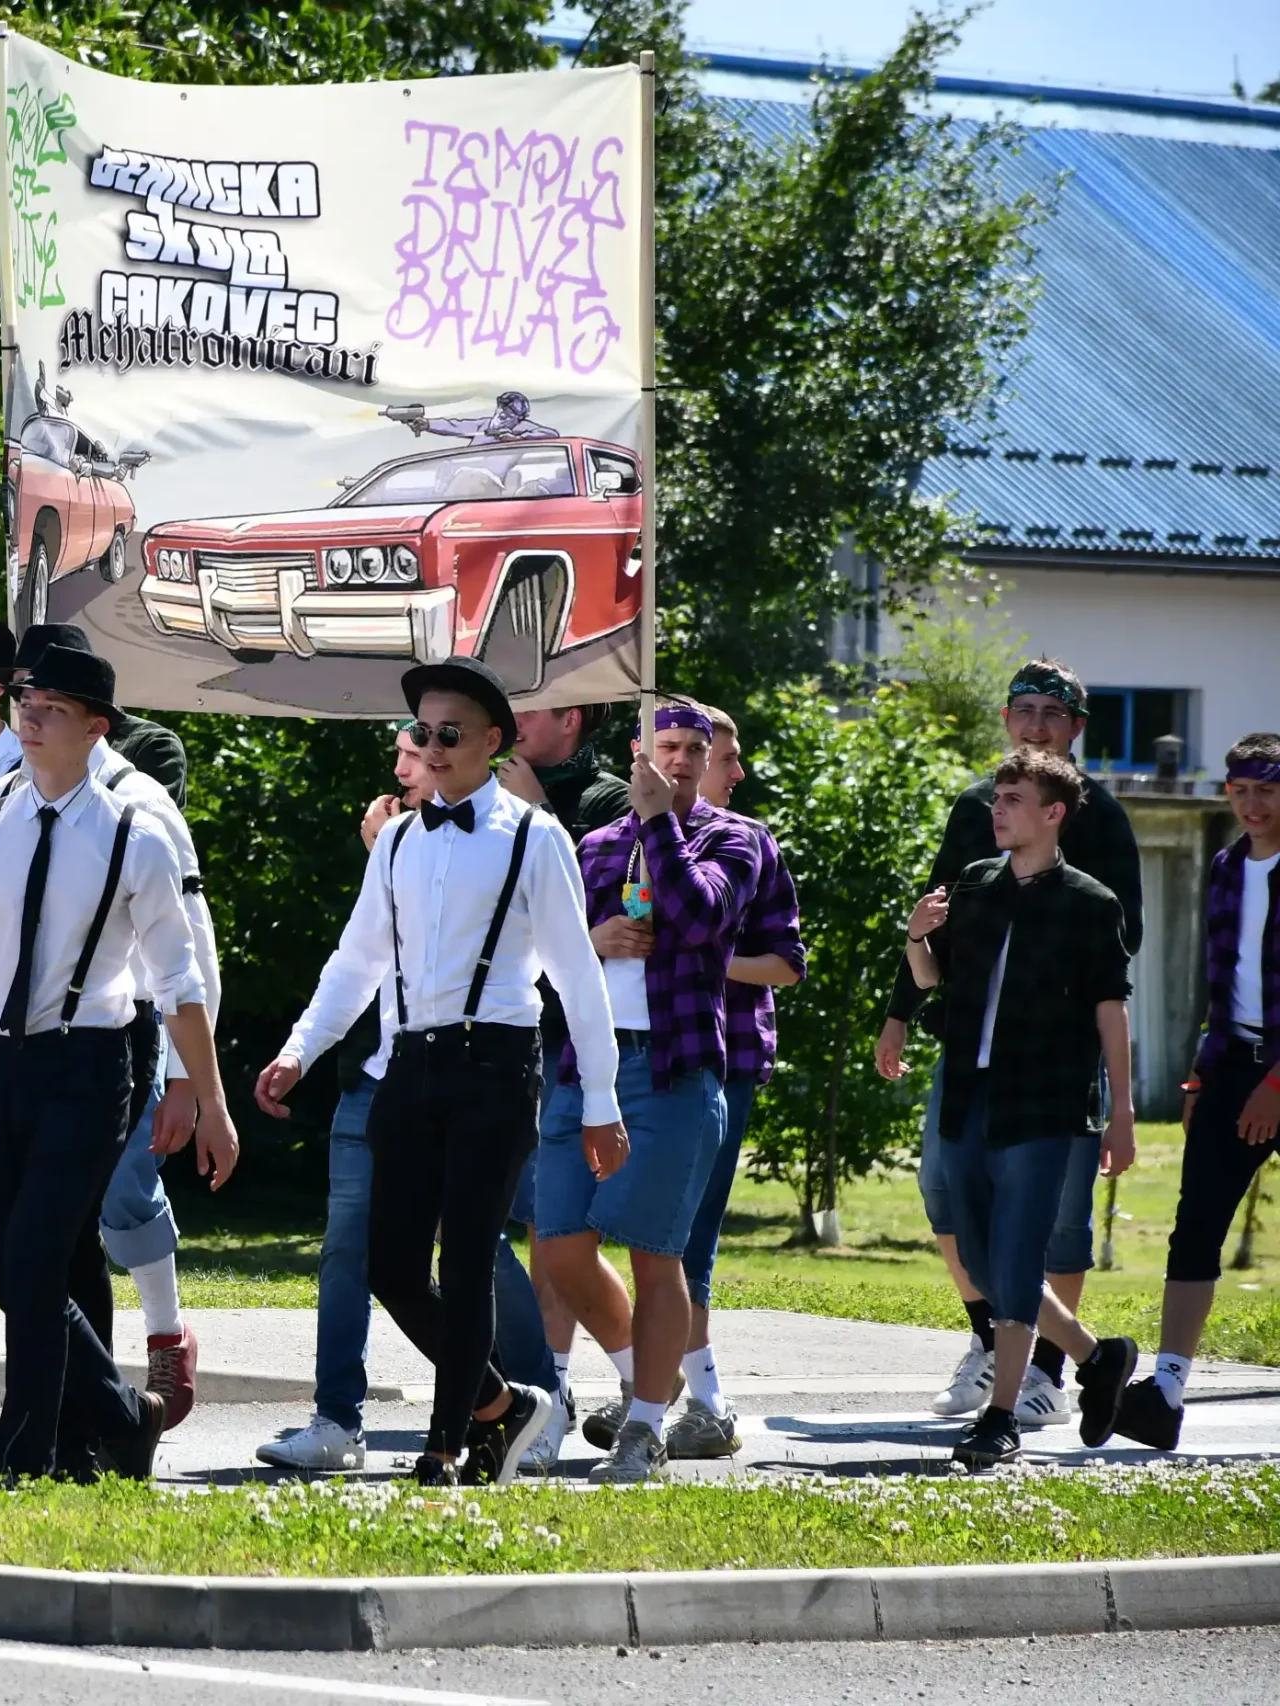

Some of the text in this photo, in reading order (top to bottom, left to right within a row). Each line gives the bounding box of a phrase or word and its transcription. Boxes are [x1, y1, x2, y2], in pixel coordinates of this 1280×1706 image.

[404, 120, 626, 230] TEMPLE
[395, 192, 608, 297] DRIVE
[100, 270, 339, 345] CAKOVEC
[385, 264, 621, 375] BALLAS
